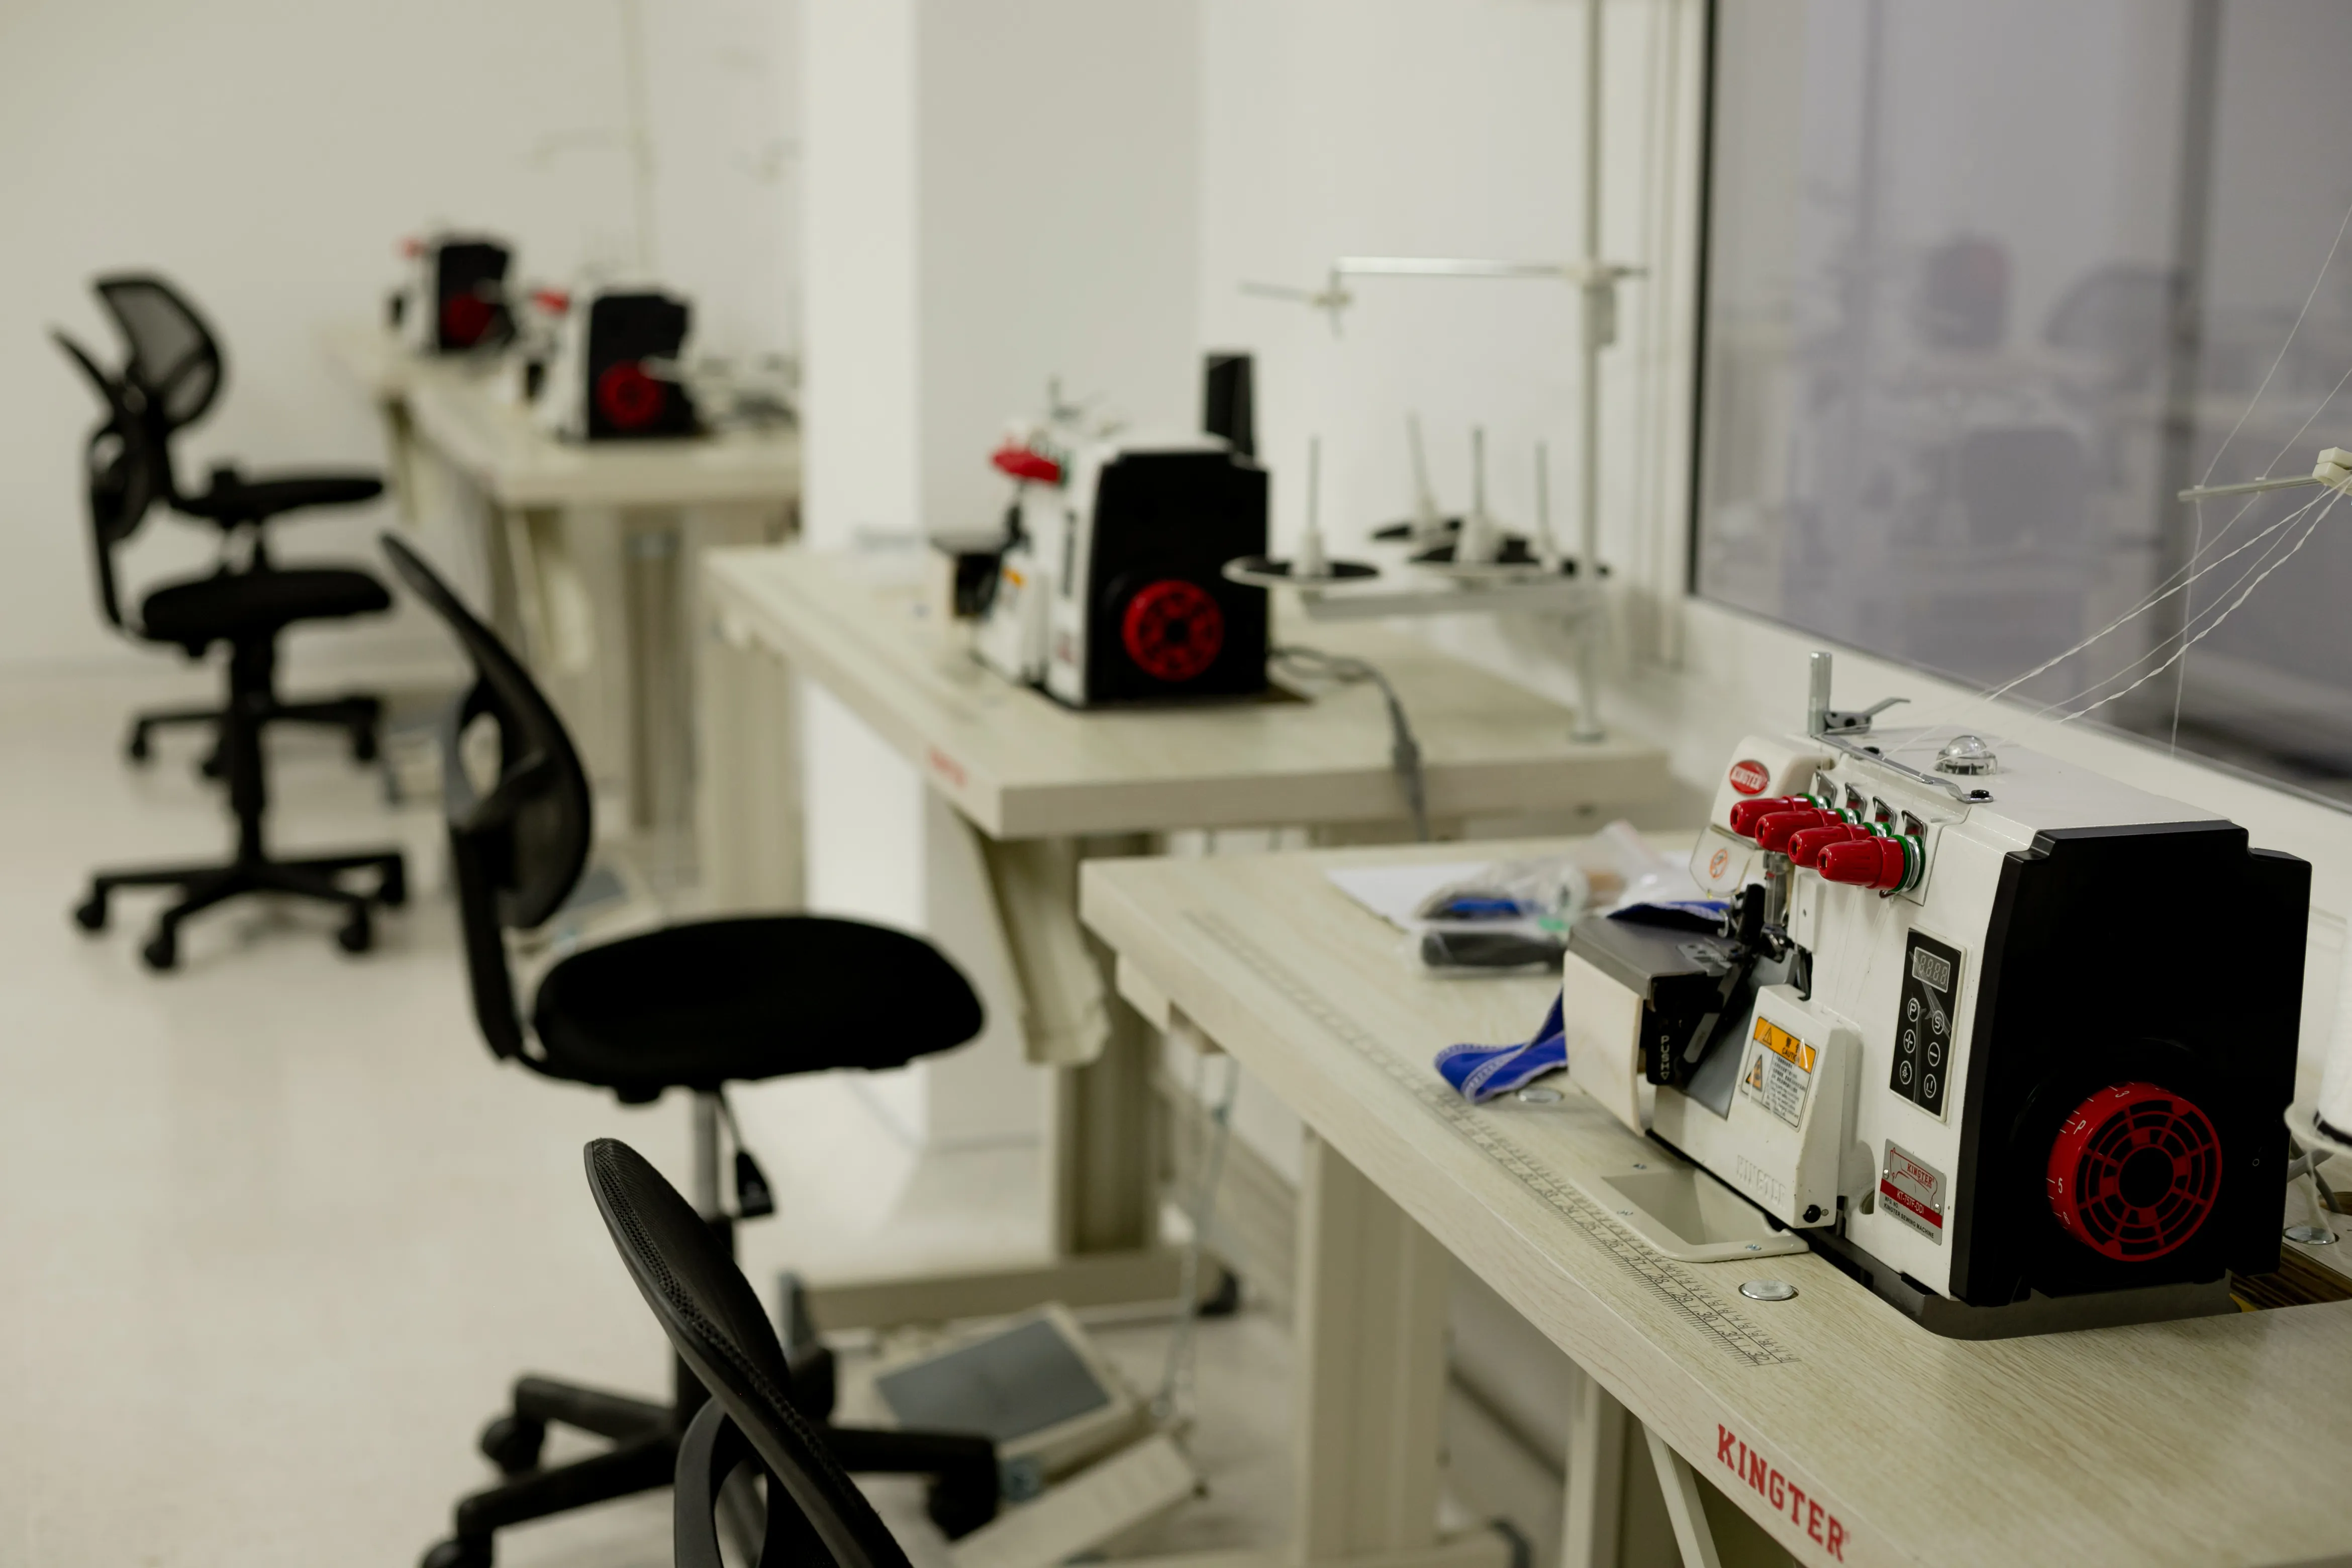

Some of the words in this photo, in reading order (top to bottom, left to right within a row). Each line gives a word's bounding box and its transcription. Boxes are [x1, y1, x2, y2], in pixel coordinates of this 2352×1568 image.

[1909, 1002, 1917, 1016] P
[1934, 1015, 1941, 1030] S
[1660, 1035, 1670, 1071] PUSH
[2057, 1177, 2063, 1194] 5
[1884, 1203, 1901, 1218] KINGTER
[1901, 1213, 1916, 1227] SEWING
[1916, 1223, 1934, 1239] MACHINE
[1624, 1256, 1647, 1264] 27
[1647, 1274, 1670, 1284] 28
[1671, 1292, 1694, 1303] 29
[1697, 1311, 1719, 1322] 30
[1721, 1331, 1744, 1342] 31
[1747, 1351, 1770, 1363] 32
[1717, 1423, 1844, 1563] KINGTER
